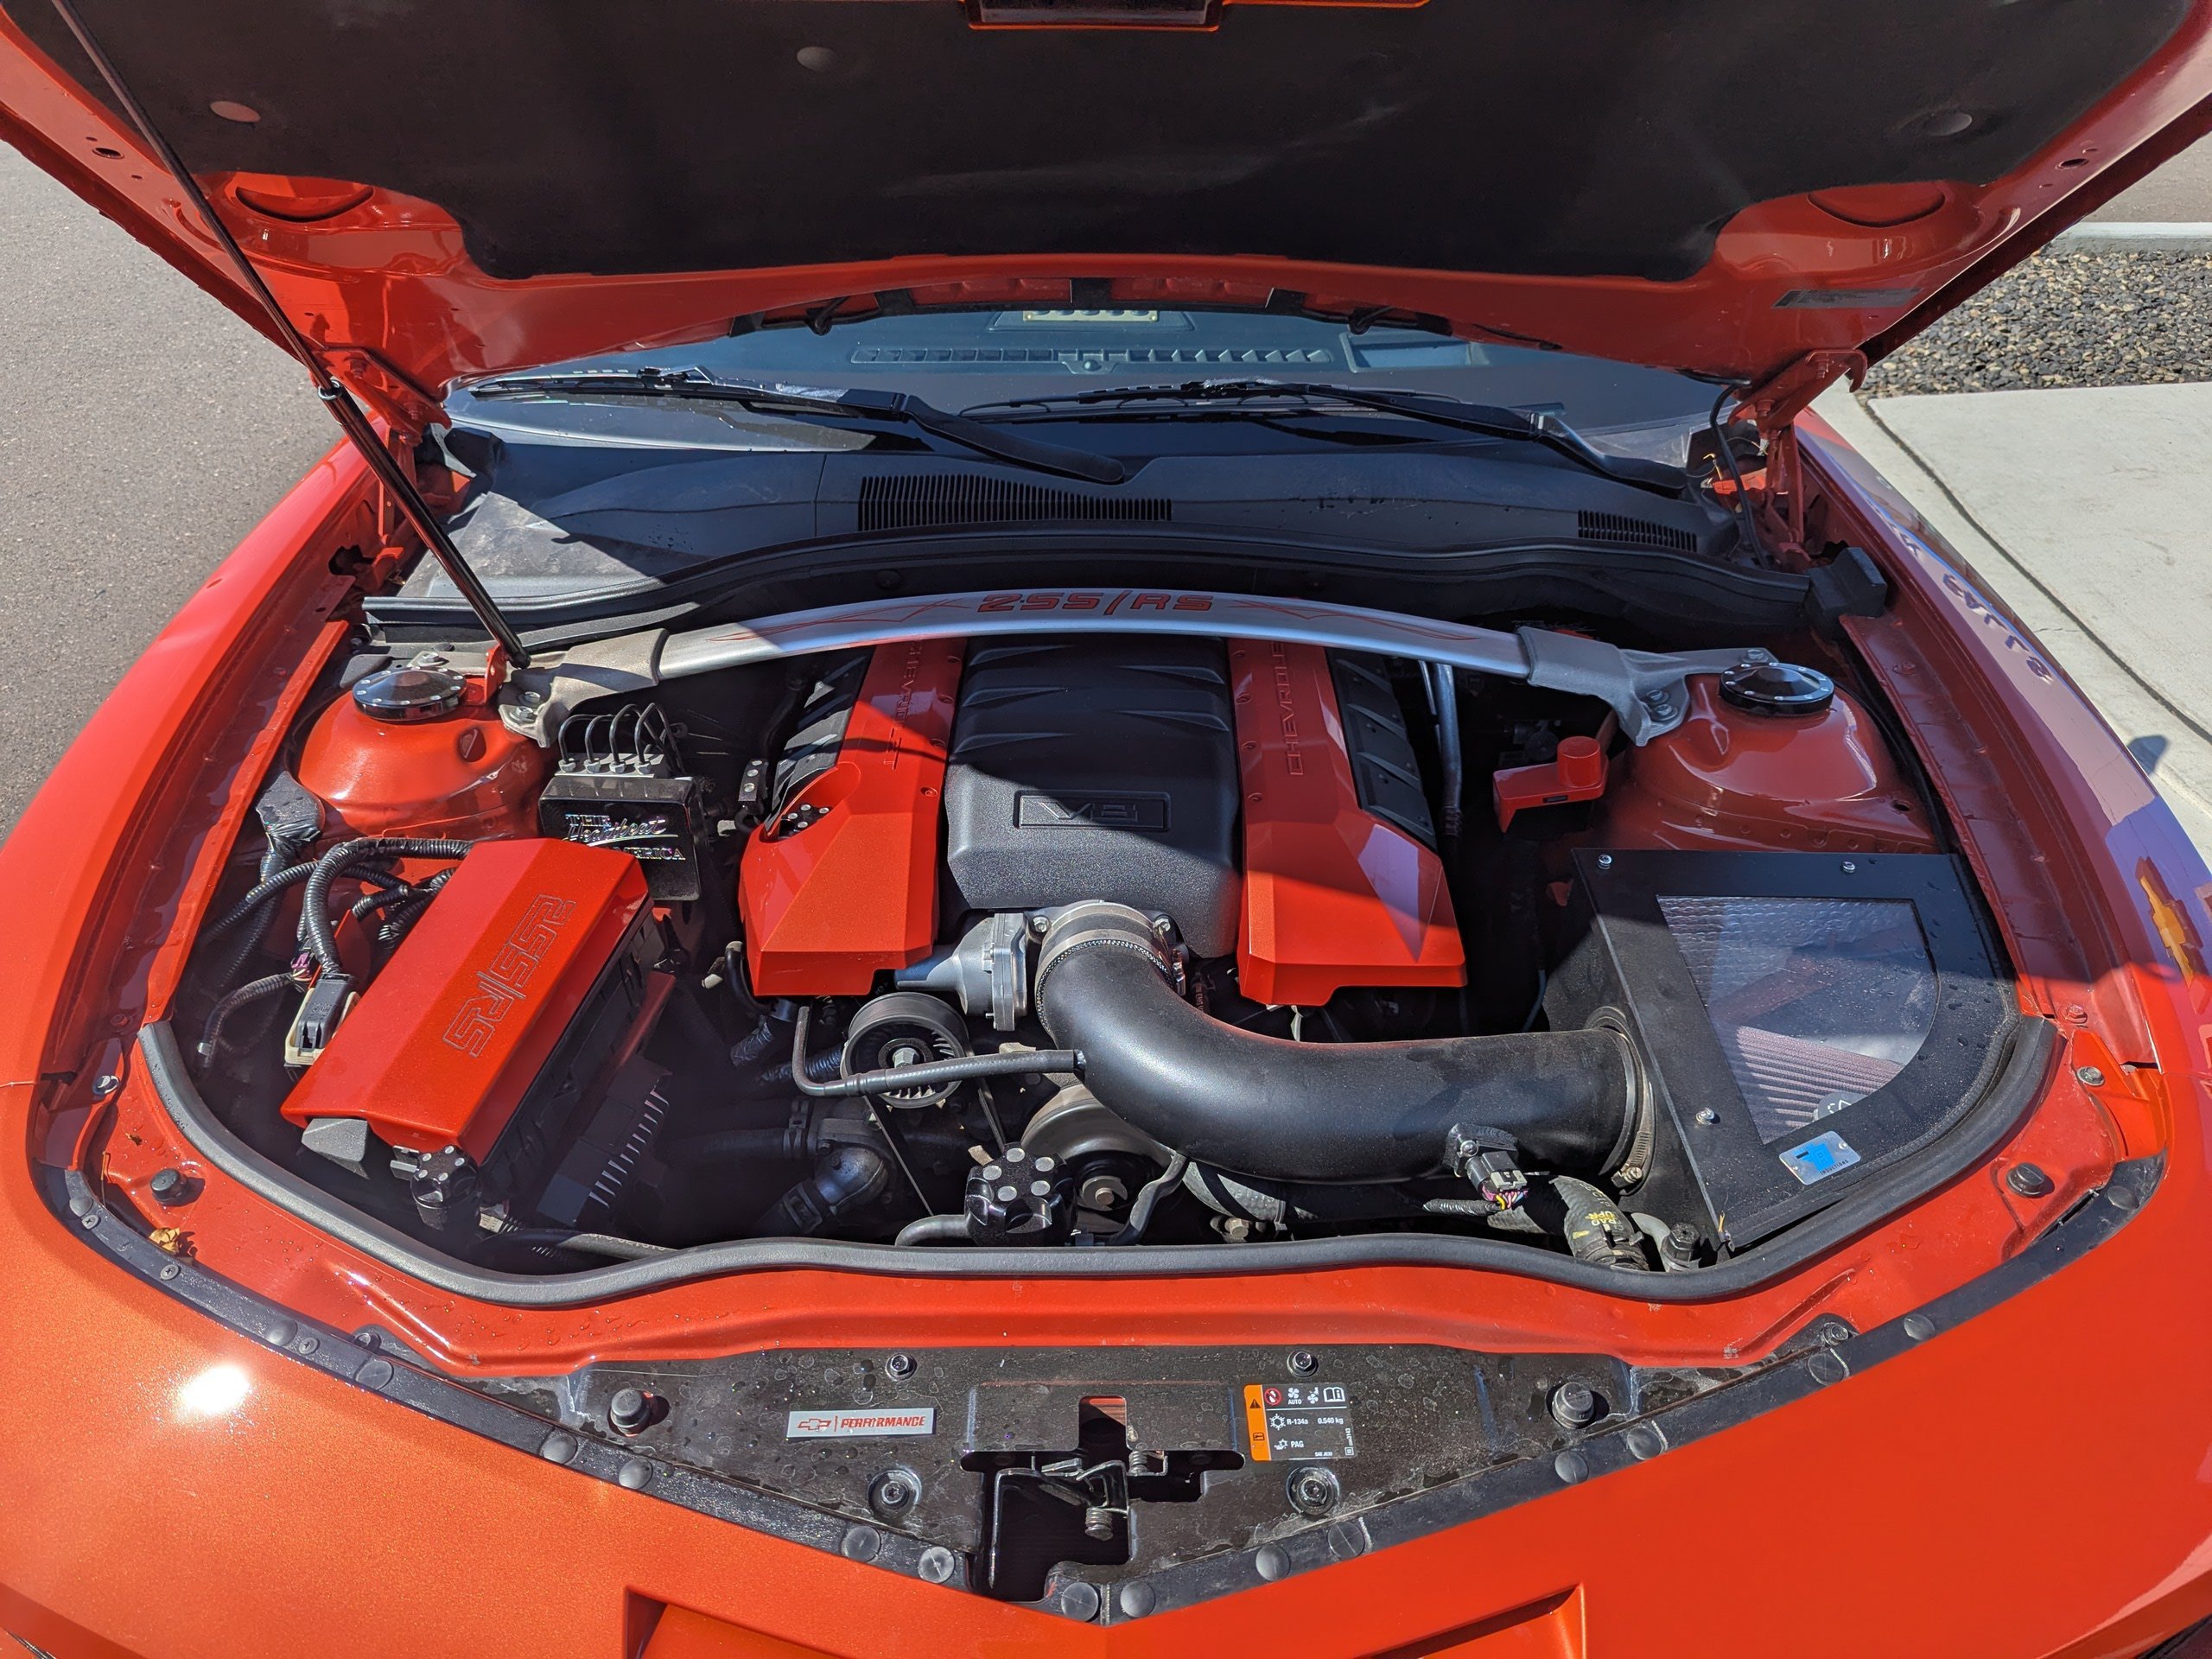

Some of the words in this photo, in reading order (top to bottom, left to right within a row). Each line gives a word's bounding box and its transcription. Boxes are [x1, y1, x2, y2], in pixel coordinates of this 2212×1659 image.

[977, 590, 1212, 615] 2SS/RS
[1271, 641, 1303, 775] CHEVROLE
[565, 814, 611, 827] THE
[1039, 802, 1138, 822] V8
[566, 817, 666, 842] Heartbeat
[442, 894, 576, 1058] 2SS/RS
